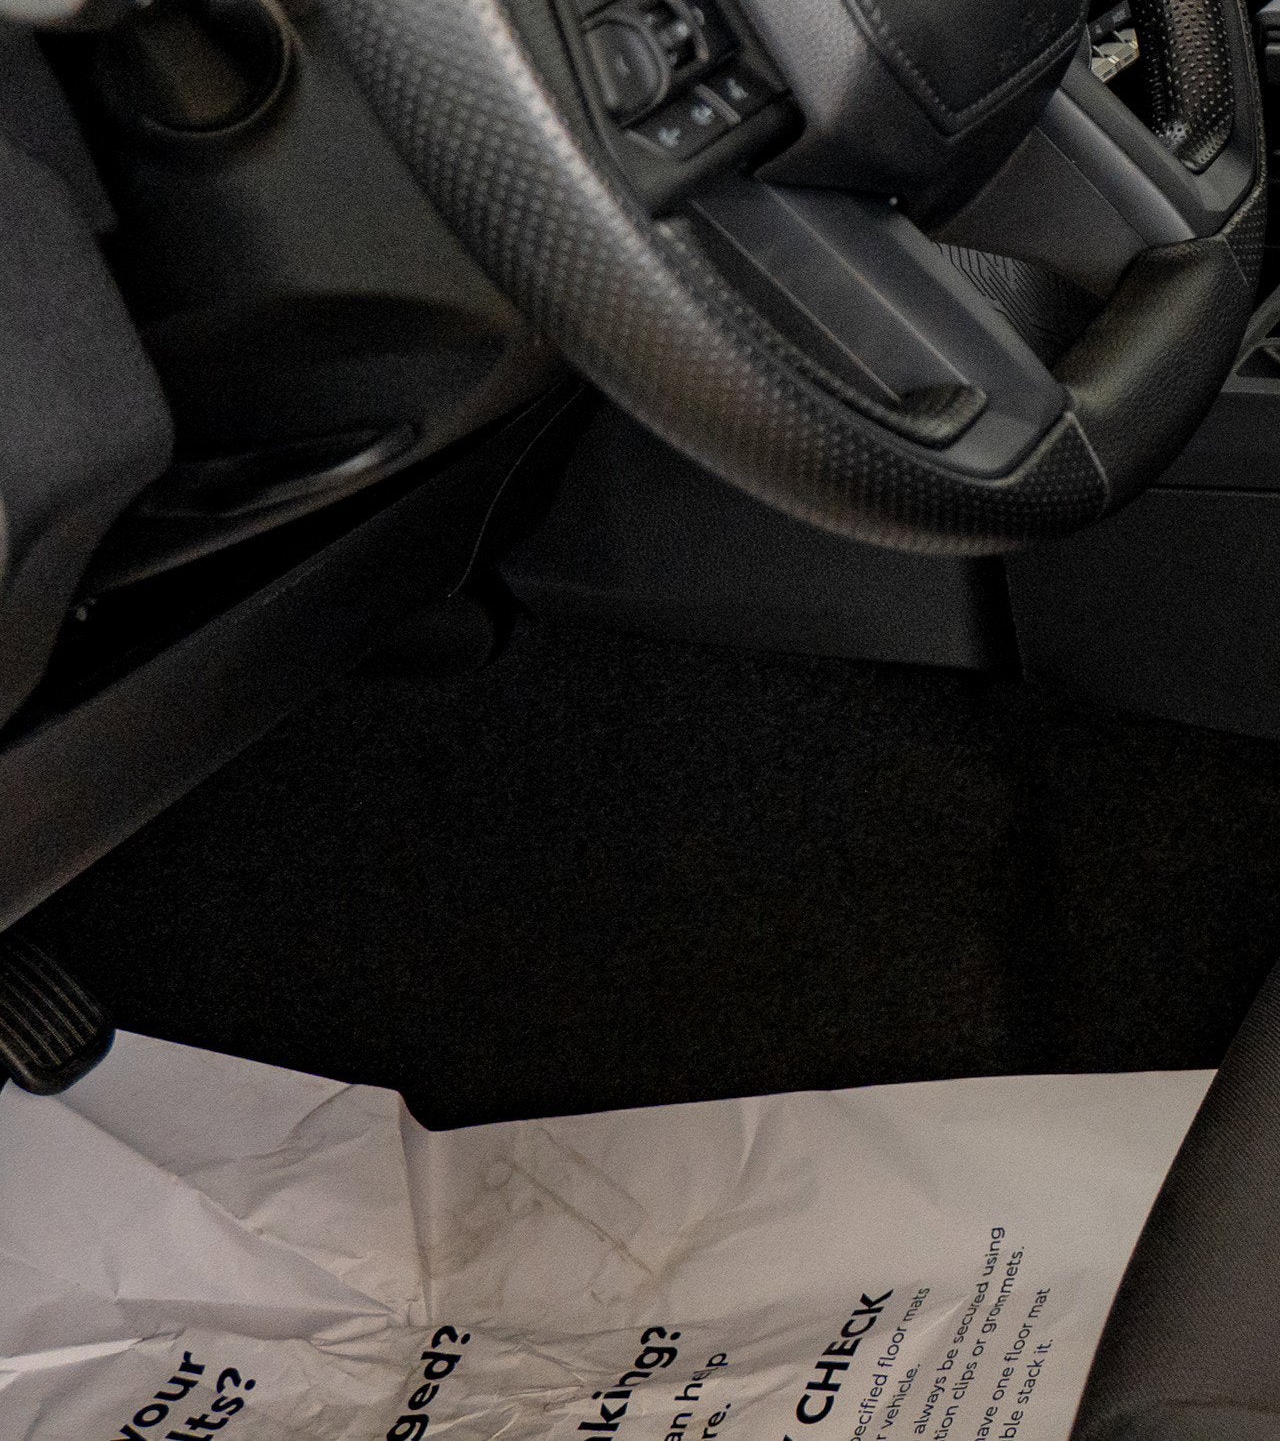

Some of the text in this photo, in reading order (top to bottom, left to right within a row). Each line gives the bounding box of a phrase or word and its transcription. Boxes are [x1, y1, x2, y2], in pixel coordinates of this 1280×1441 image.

[796, 1288, 894, 1425] CHECK
[878, 1325, 907, 1367] floor
[903, 1287, 930, 1322] mats
[913, 1227, 1006, 1435] always be secured using
[952, 1361, 978, 1400] clips
[972, 1339, 987, 1357] or
[981, 1246, 1026, 1334] grommets.
[993, 1366, 1014, 1401] one
[1004, 1323, 1032, 1363] floor
[1028, 1287, 1051, 1319] mat
[1018, 1359, 1046, 1405] stack
[1033, 1339, 1054, 1355] it.
[880, 1363, 921, 1430] vehicle.
